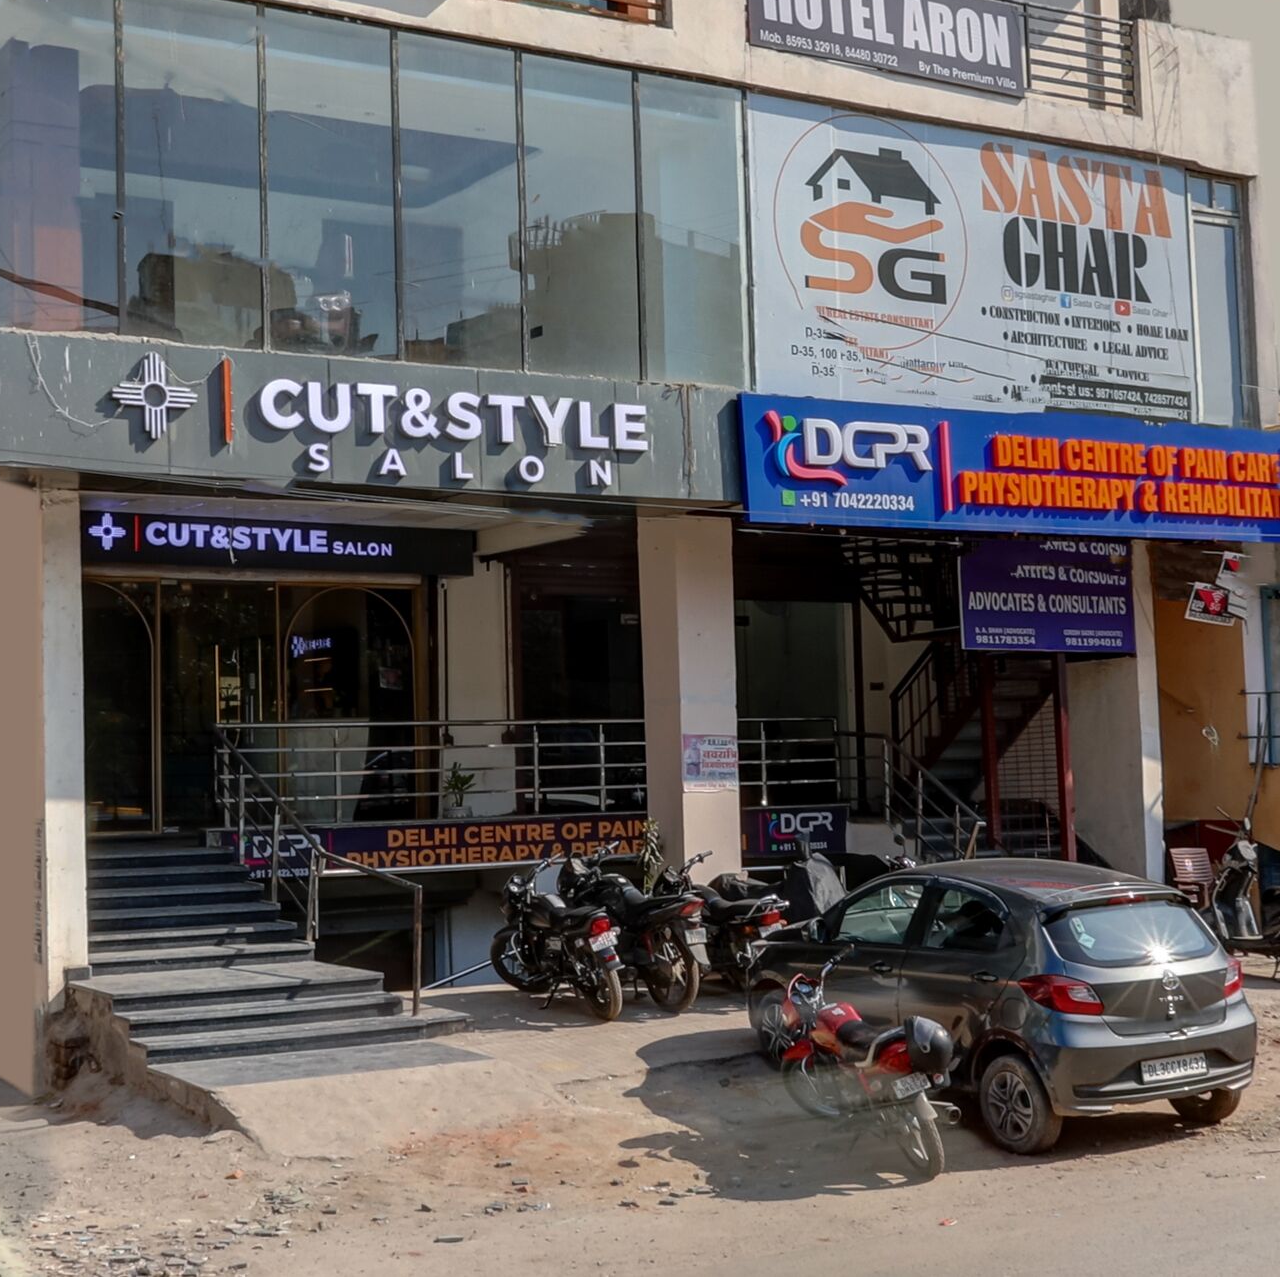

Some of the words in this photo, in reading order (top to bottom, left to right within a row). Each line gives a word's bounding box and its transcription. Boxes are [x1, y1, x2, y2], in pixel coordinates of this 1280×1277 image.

[760, 30, 784, 45] Mob.
[785, 34, 813, 50] 85953
[844, 46, 871, 62] 84480
[872, 51, 899, 67] 30722
[919, 61, 931, 75] By
[932, 63, 951, 77] The
[952, 68, 994, 86] Premium
[996, 76, 1017, 90] Villa
[979, 141, 1173, 239] SASTA
[1002, 216, 1152, 304] GHAR
[880, 312, 934, 329] CONSULTANT
[989, 306, 1061, 326] CONSTRUCTION
[1072, 315, 1121, 333] INTERIORS
[1136, 324, 1163, 339] HOME
[1165, 328, 1189, 341] LOAN
[820, 348, 837, 360] 100
[1011, 330, 1087, 351] ARCHITECTURE
[1102, 341, 1133, 356] LEGAL
[1135, 344, 1169, 360] ADVICE
[260, 378, 649, 452] CUT&STYLE
[803, 418, 933, 471] DCPR
[994, 435, 1061, 470] DELHI
[1062, 439, 1147, 474] CENTRE
[1148, 445, 1178, 477] OF
[1180, 448, 1227, 480] PAIN
[307, 443, 614, 488] SALON
[799, 493, 829, 508] +91
[833, 491, 915, 511] 7042220334
[960, 471, 1136, 511] PHYSIOTHERAPY
[1139, 480, 1158, 513] &
[145, 521, 329, 554] CUT&STYLE
[332, 540, 393, 557] SALON
[968, 591, 1035, 613] ADVOCATES
[1037, 593, 1047, 613] &
[1048, 594, 1127, 615] CONSULTANTS
[387, 827, 457, 849] DELHI
[464, 823, 555, 844] CENTRE
[561, 822, 592, 840] OF
[598, 820, 645, 838] PAIN
[780, 812, 833, 833] DCPR
[346, 843, 544, 869] PHYSIOTHERAPY
